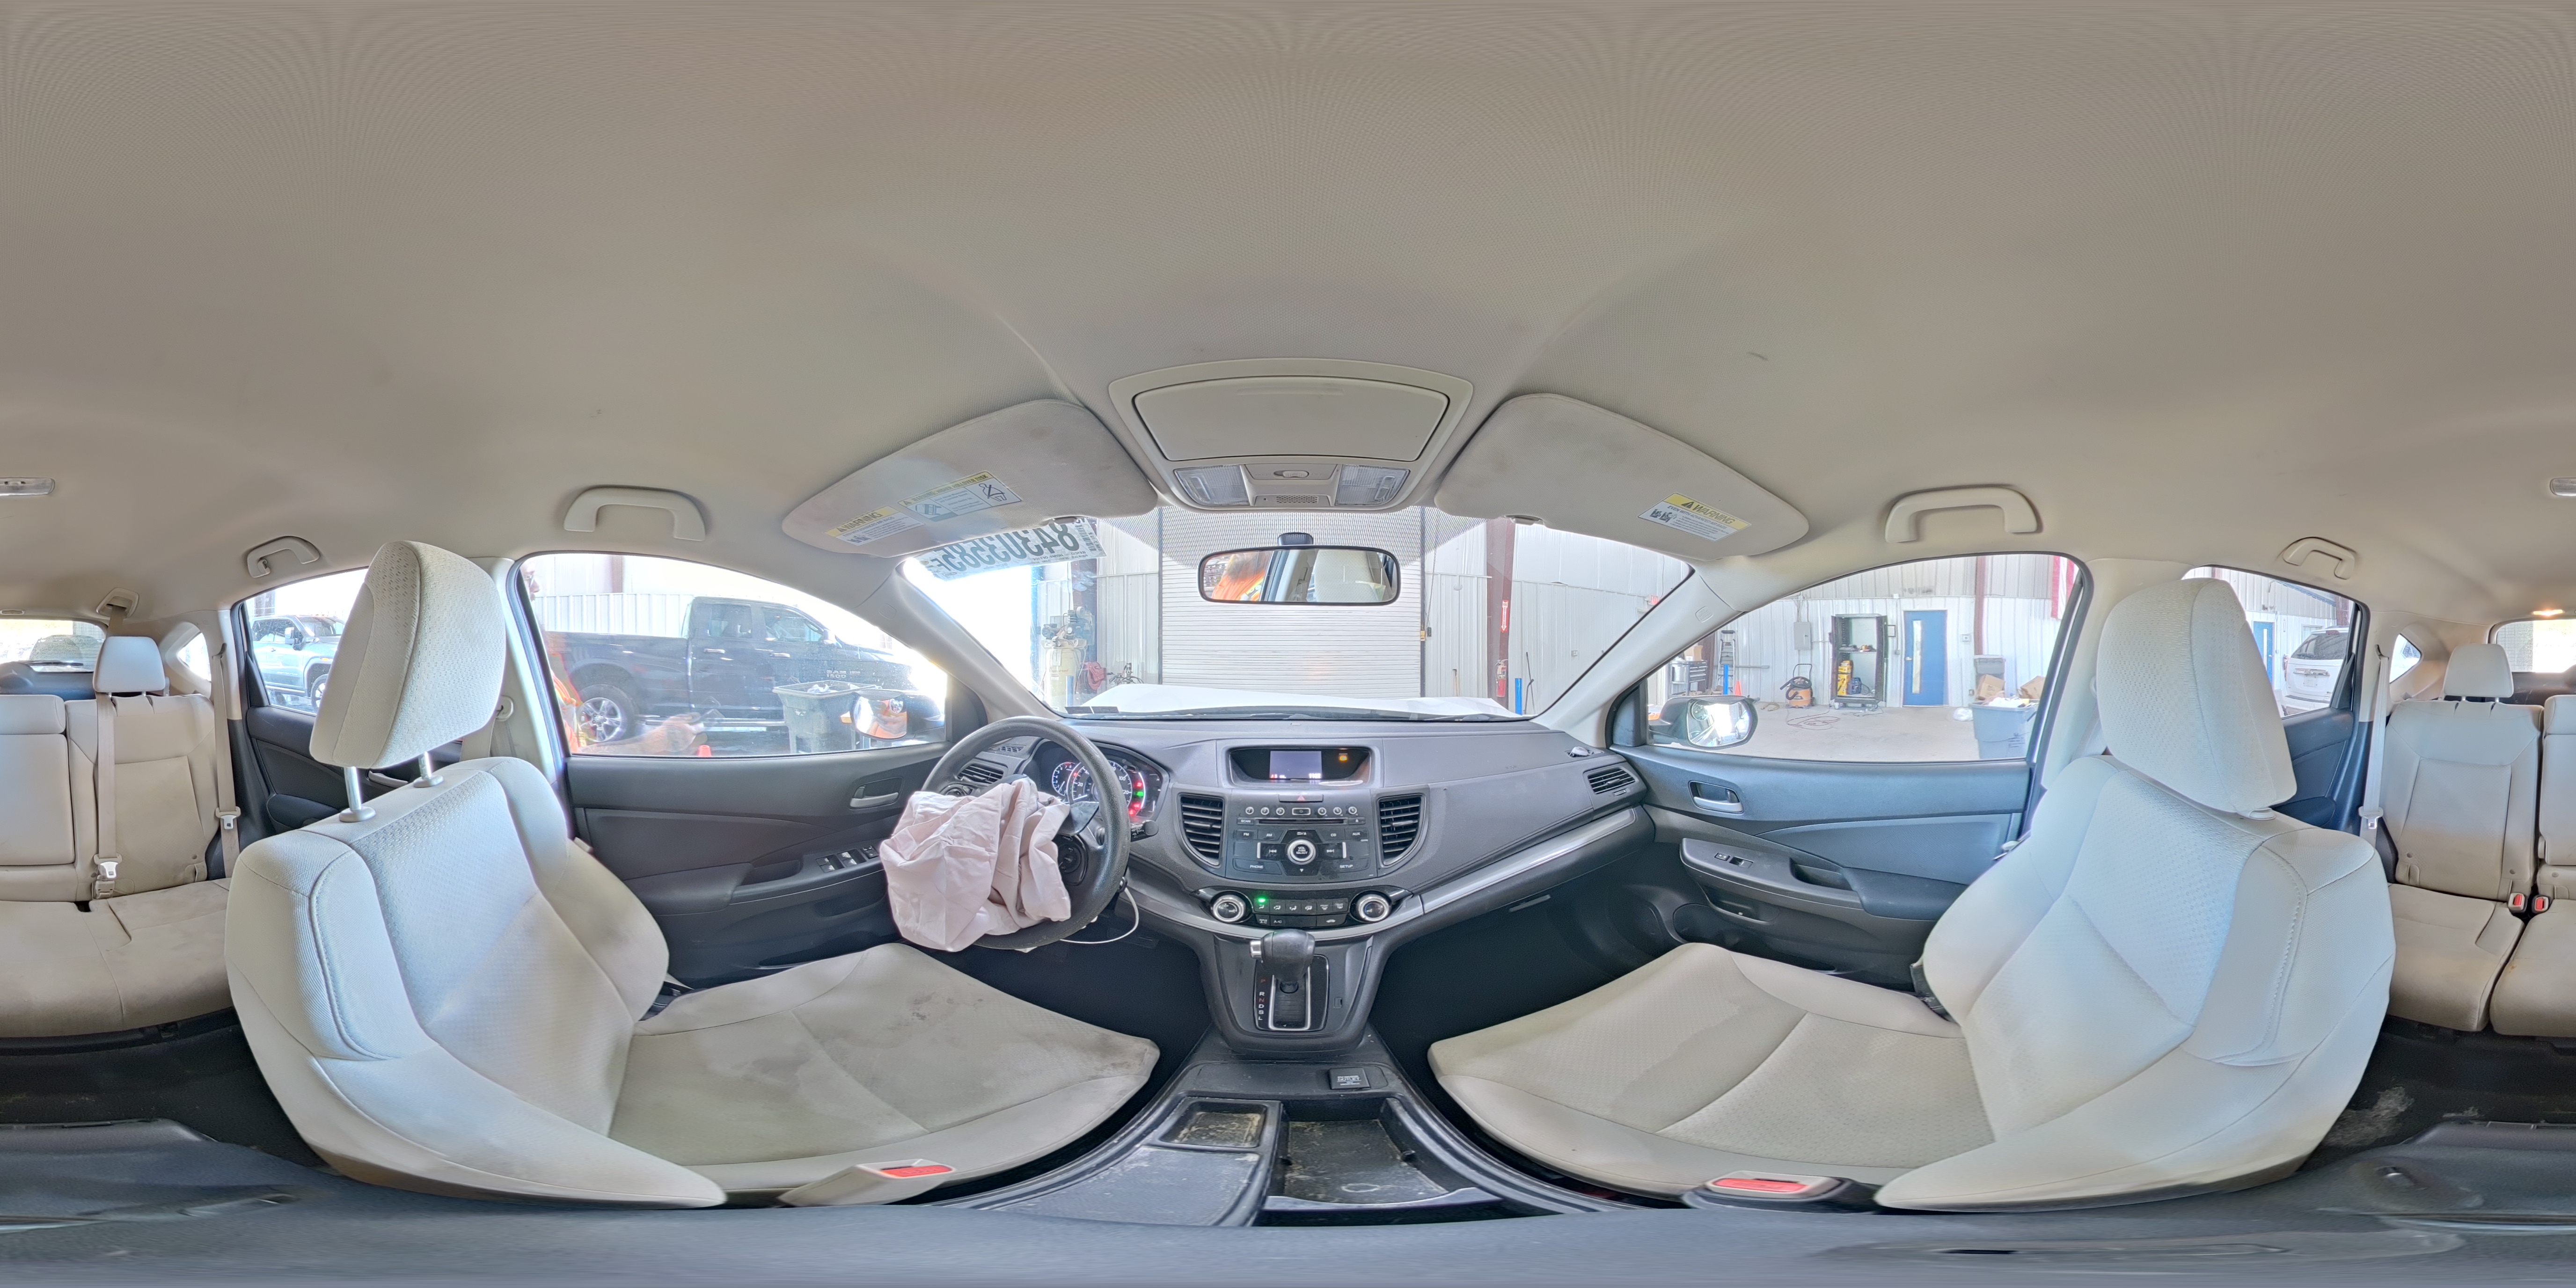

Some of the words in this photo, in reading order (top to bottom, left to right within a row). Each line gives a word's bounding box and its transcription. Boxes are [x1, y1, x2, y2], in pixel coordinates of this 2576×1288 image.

[843, 512, 884, 530] WARNING
[1690, 513, 1711, 524] ADVANCED
[1692, 505, 1735, 525] WARNING
